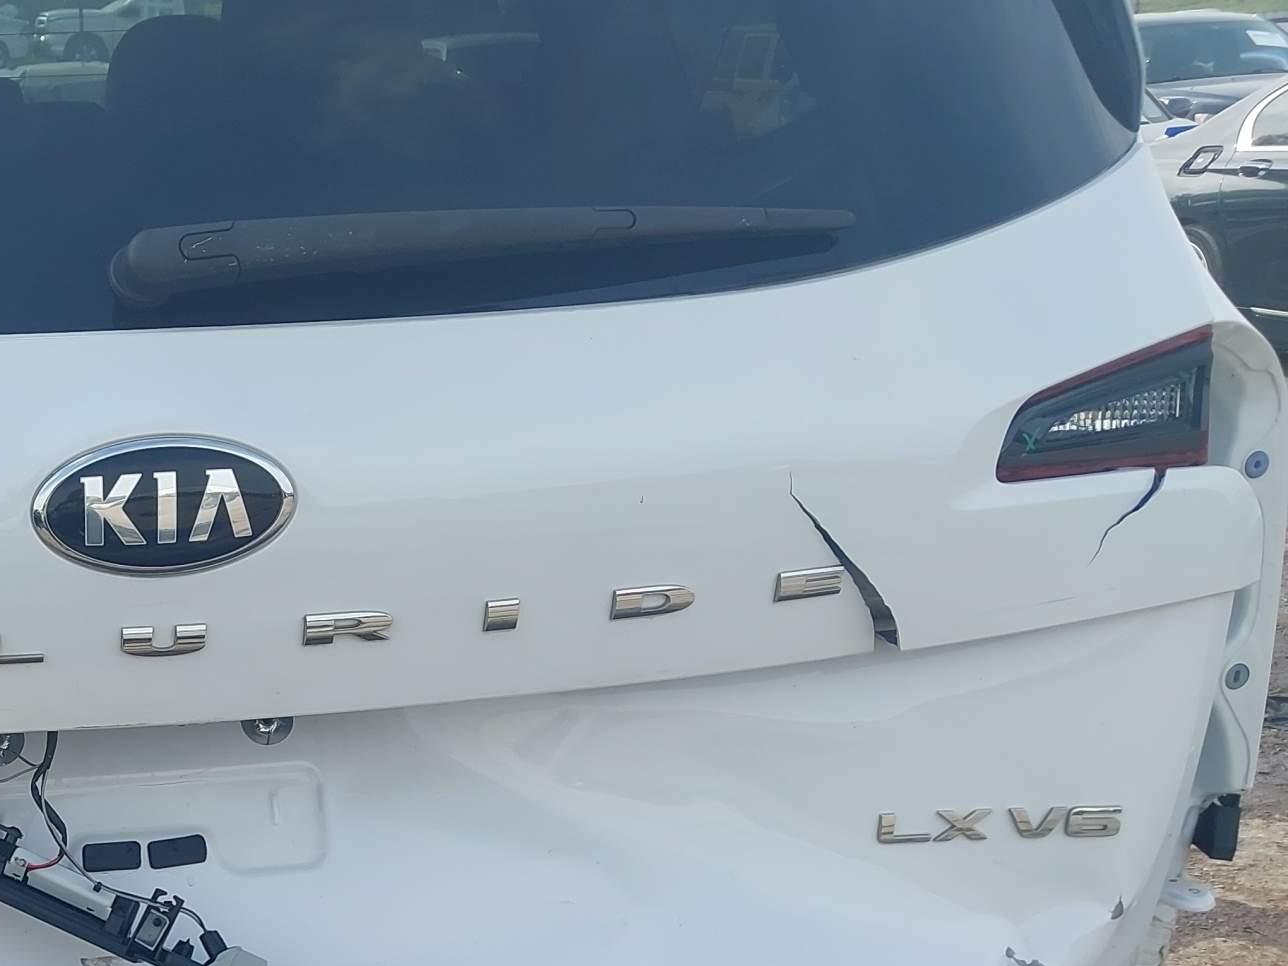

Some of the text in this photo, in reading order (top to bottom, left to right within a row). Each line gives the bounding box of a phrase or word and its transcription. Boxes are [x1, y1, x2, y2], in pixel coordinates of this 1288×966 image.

[79, 468, 253, 547] KIA
[877, 805, 1123, 843] LX V6
